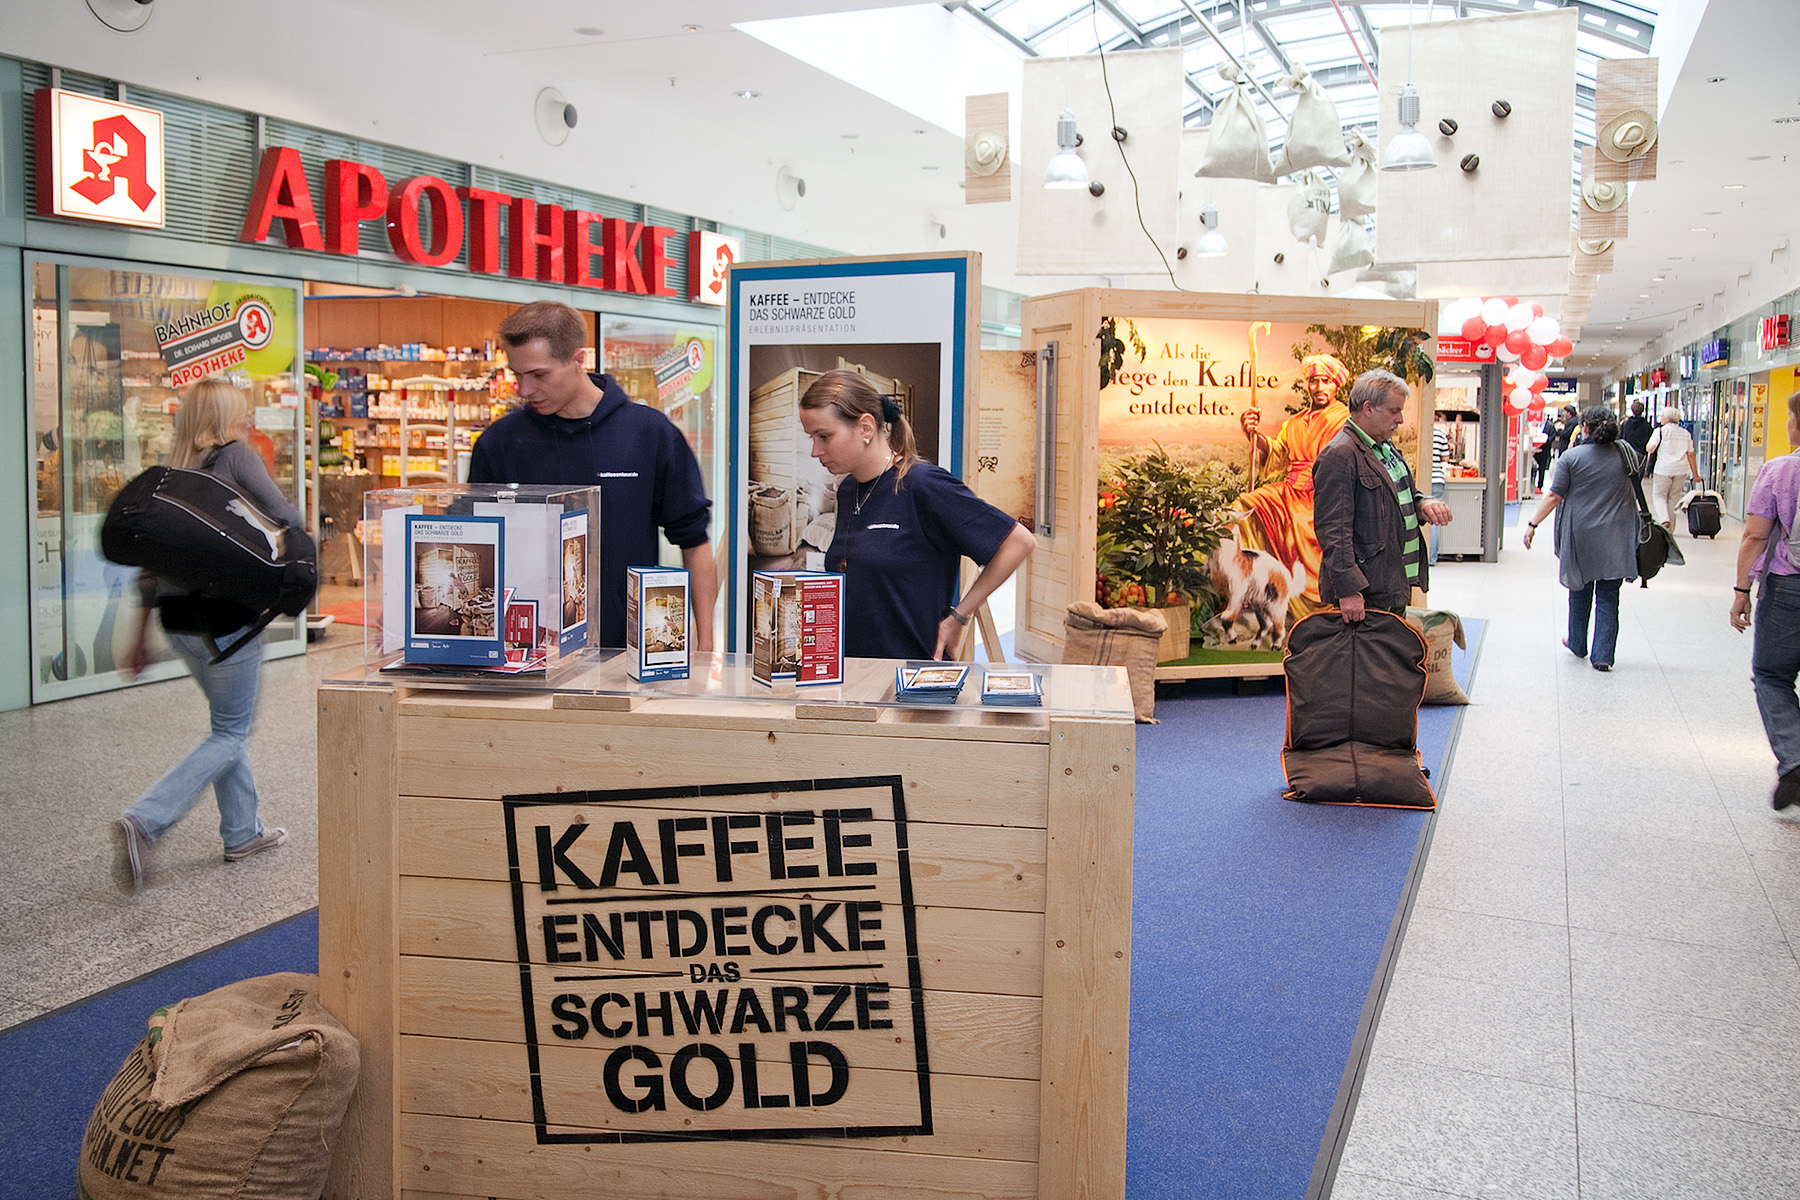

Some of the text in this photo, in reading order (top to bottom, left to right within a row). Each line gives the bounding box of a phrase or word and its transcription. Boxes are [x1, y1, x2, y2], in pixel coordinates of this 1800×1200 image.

[239, 146, 677, 298] APOTHEKE
[749, 293, 789, 307] KAFFEE
[803, 290, 856, 305] ENTDECKE
[156, 302, 231, 342] BAHNHOF
[749, 305, 856, 321] DAS SCHWARZE GOLD
[748, 323, 856, 334] ERLEBNISPRÄSENTATION
[173, 349, 184, 358] DR.
[184, 339, 210, 354] ECKHARD
[1159, 342, 1211, 360] Als die
[172, 348, 246, 388] APOTHEKE
[1110, 371, 1157, 396] iege
[1162, 370, 1188, 387] den
[1129, 391, 1235, 416] entdeckte.
[1426, 662, 1441, 674] SIL
[534, 807, 879, 892] KAFFEE
[541, 900, 886, 963] ENTDECKE
[688, 961, 741, 984] DAS
[550, 982, 894, 1040] SCHWARZE
[602, 1041, 850, 1114] GOLD
